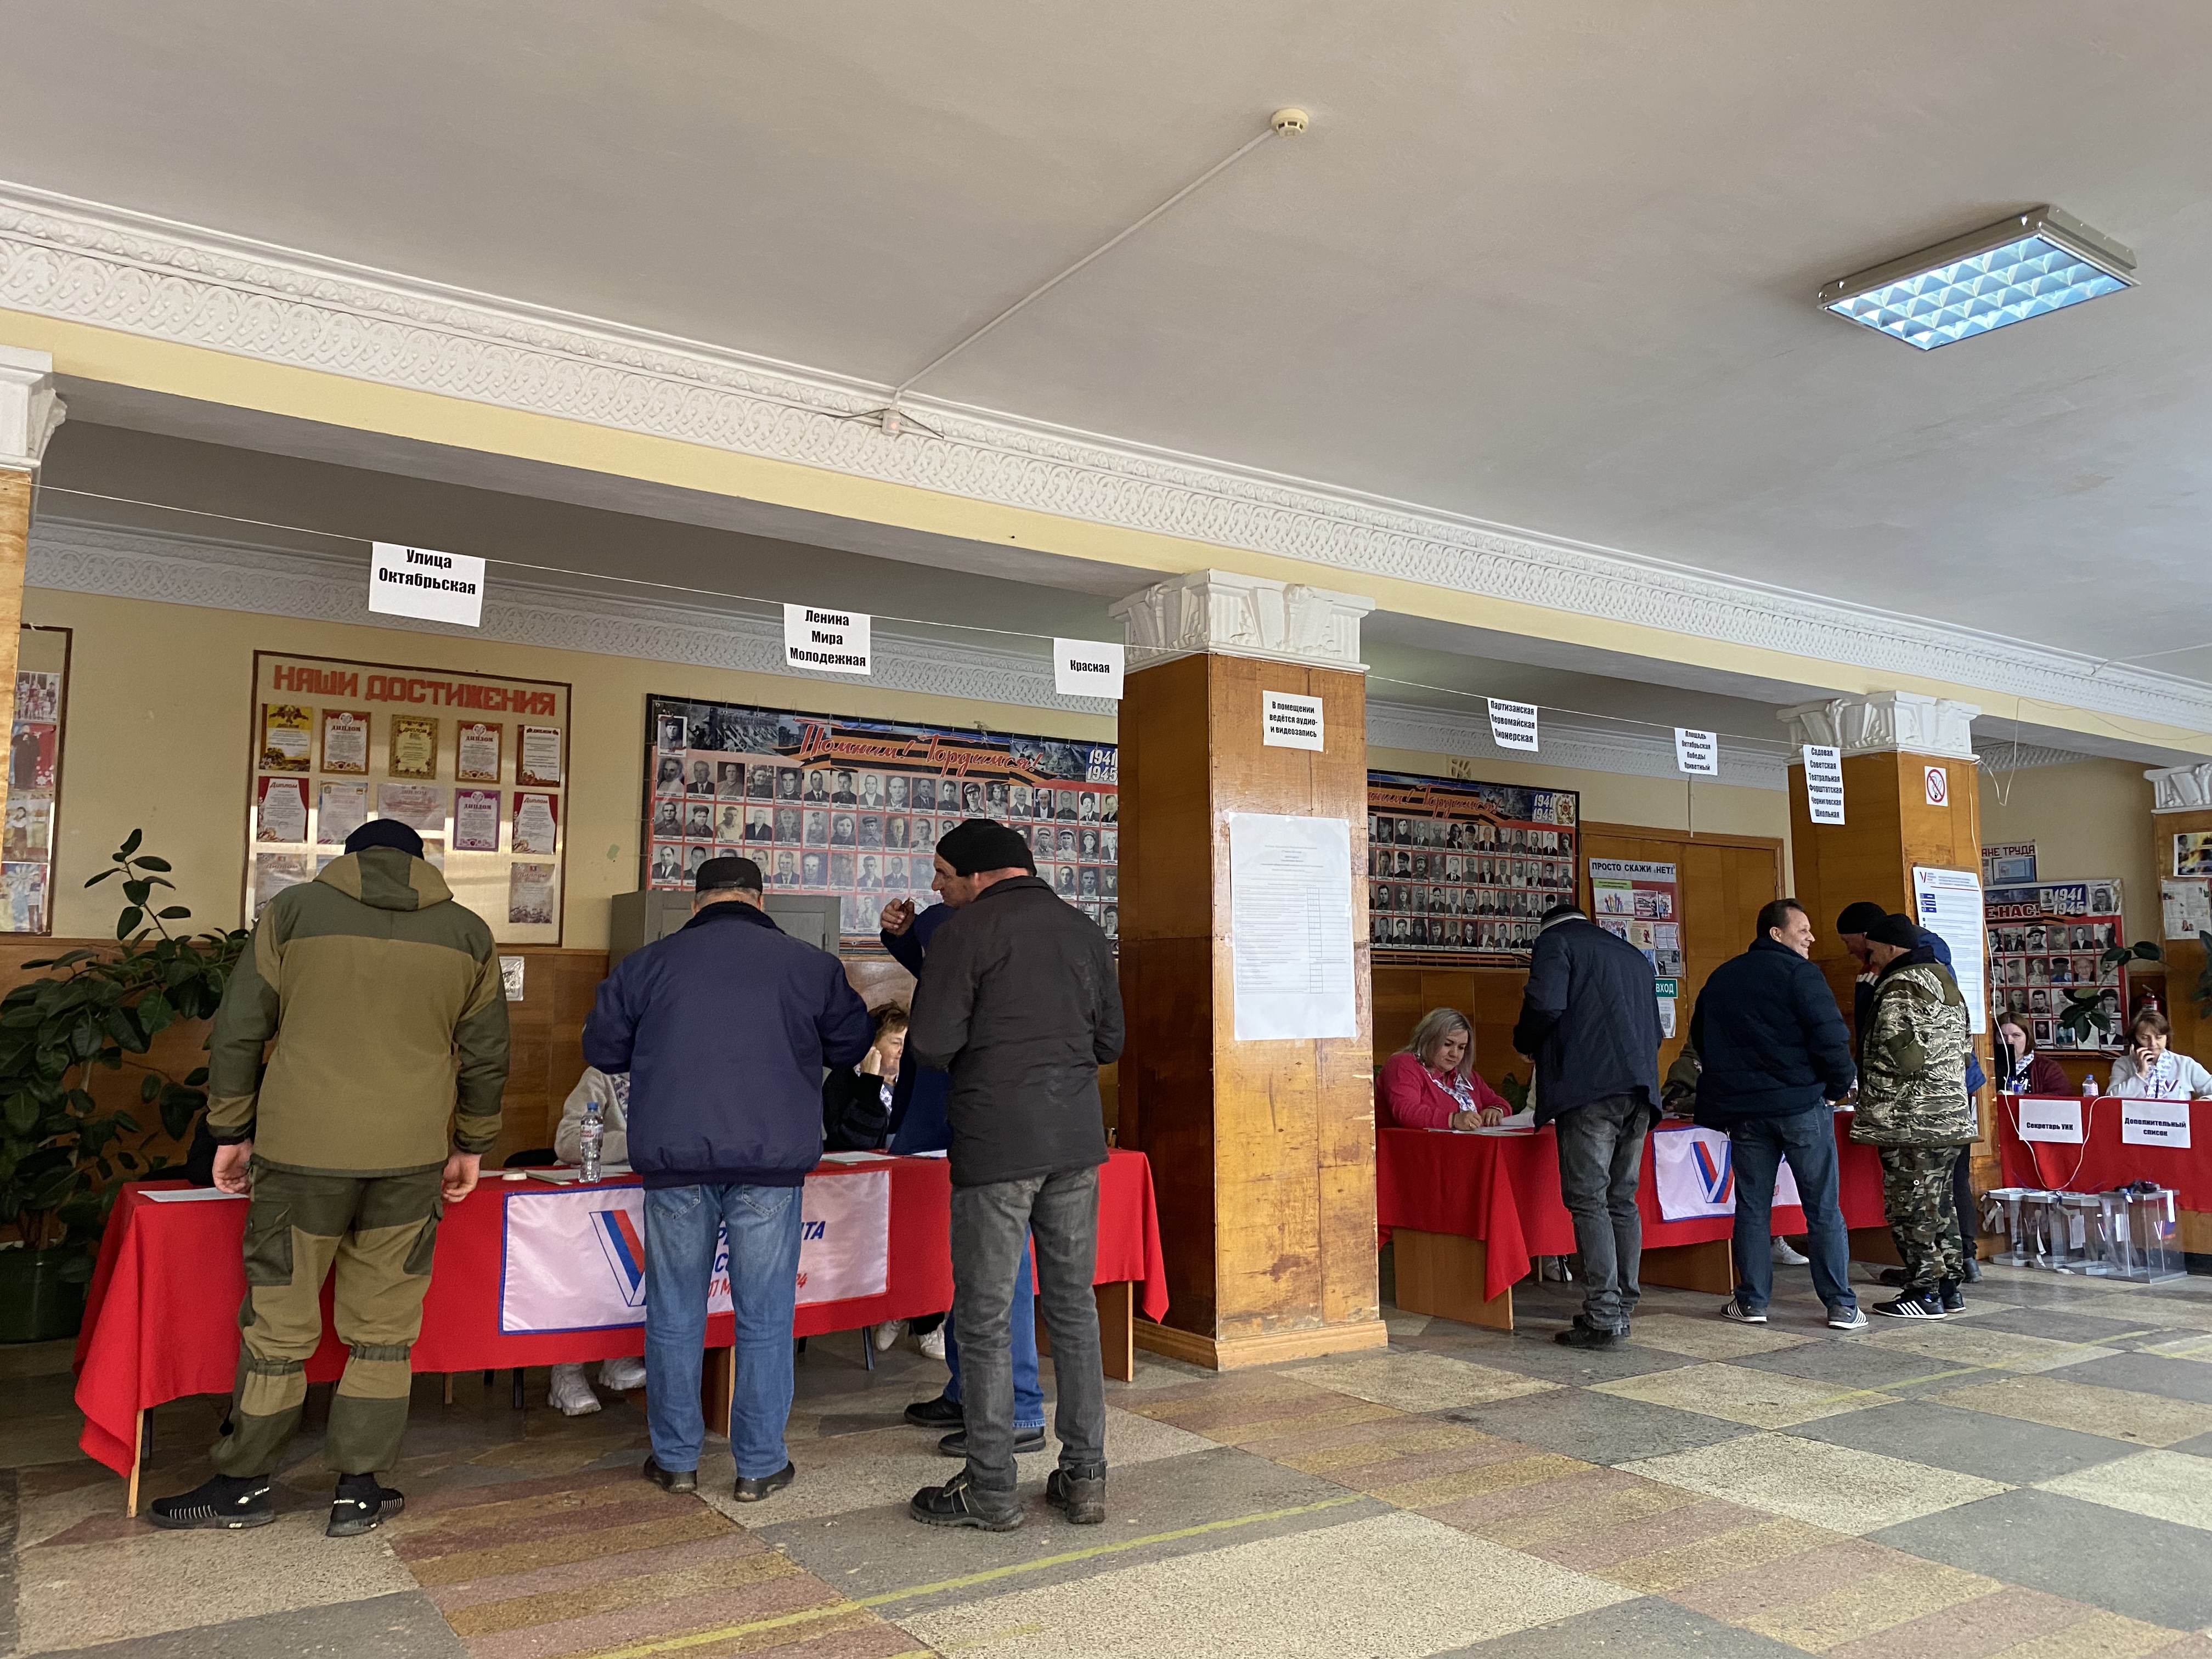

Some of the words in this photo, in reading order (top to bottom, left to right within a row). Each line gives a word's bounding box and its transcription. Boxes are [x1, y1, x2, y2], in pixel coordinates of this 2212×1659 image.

[407, 549, 452, 569] Улица
[379, 567, 476, 595] Октябрьская
[805, 610, 849, 626] Ленина
[811, 630, 843, 645] Мира
[789, 647, 866, 667] Молодежная
[1070, 659, 1110, 673] Красная
[274, 664, 358, 697] НАШИ
[365, 675, 556, 716] ДОСТИЖЕНИЯ
[1277, 703, 1314, 714] помещении
[1491, 701, 1534, 715] Партизанская
[1269, 714, 1295, 723] ведётся
[1296, 717, 1318, 726] аудио-
[1491, 714, 1535, 729] Первомайская
[1276, 727, 1317, 737] видеозапись
[1494, 728, 1533, 743] Пионерская
[1685, 730, 1706, 740] Площадь
[794, 718, 916, 759] Помним!
[917, 733, 1043, 779] Гордимся!
[1681, 740, 1711, 750] Октябрьская
[1811, 747, 1833, 757] Садовая
[1088, 749, 1116, 766] 1941
[1687, 752, 1706, 760] Победы
[1810, 760, 1836, 770] Советская
[1086, 765, 1118, 782] 1945
[1808, 772, 1840, 782] Театральная
[1809, 784, 1842, 794] Форштатская
[1534, 794, 1554, 808] 1941
[1533, 808, 1554, 822] 1945
[1815, 809, 1840, 818] Школьная
[1982, 848, 2000, 857] АНЕ
[2002, 845, 2035, 856] ТРУДА
[1592, 862, 1622, 871] ПРОСТО
[1624, 864, 1651, 873] СКАЖИ
[1656, 866, 1674, 874] НЕТ!
[2053, 887, 2083, 901] 1941
[1999, 904, 2040, 918] НАС!
[2053, 901, 2084, 916] 1945
[1656, 983, 1674, 995] ВХОД
[2027, 1122, 2061, 1130] Секретарь
[2124, 1117, 2186, 1128] Дополнительный
